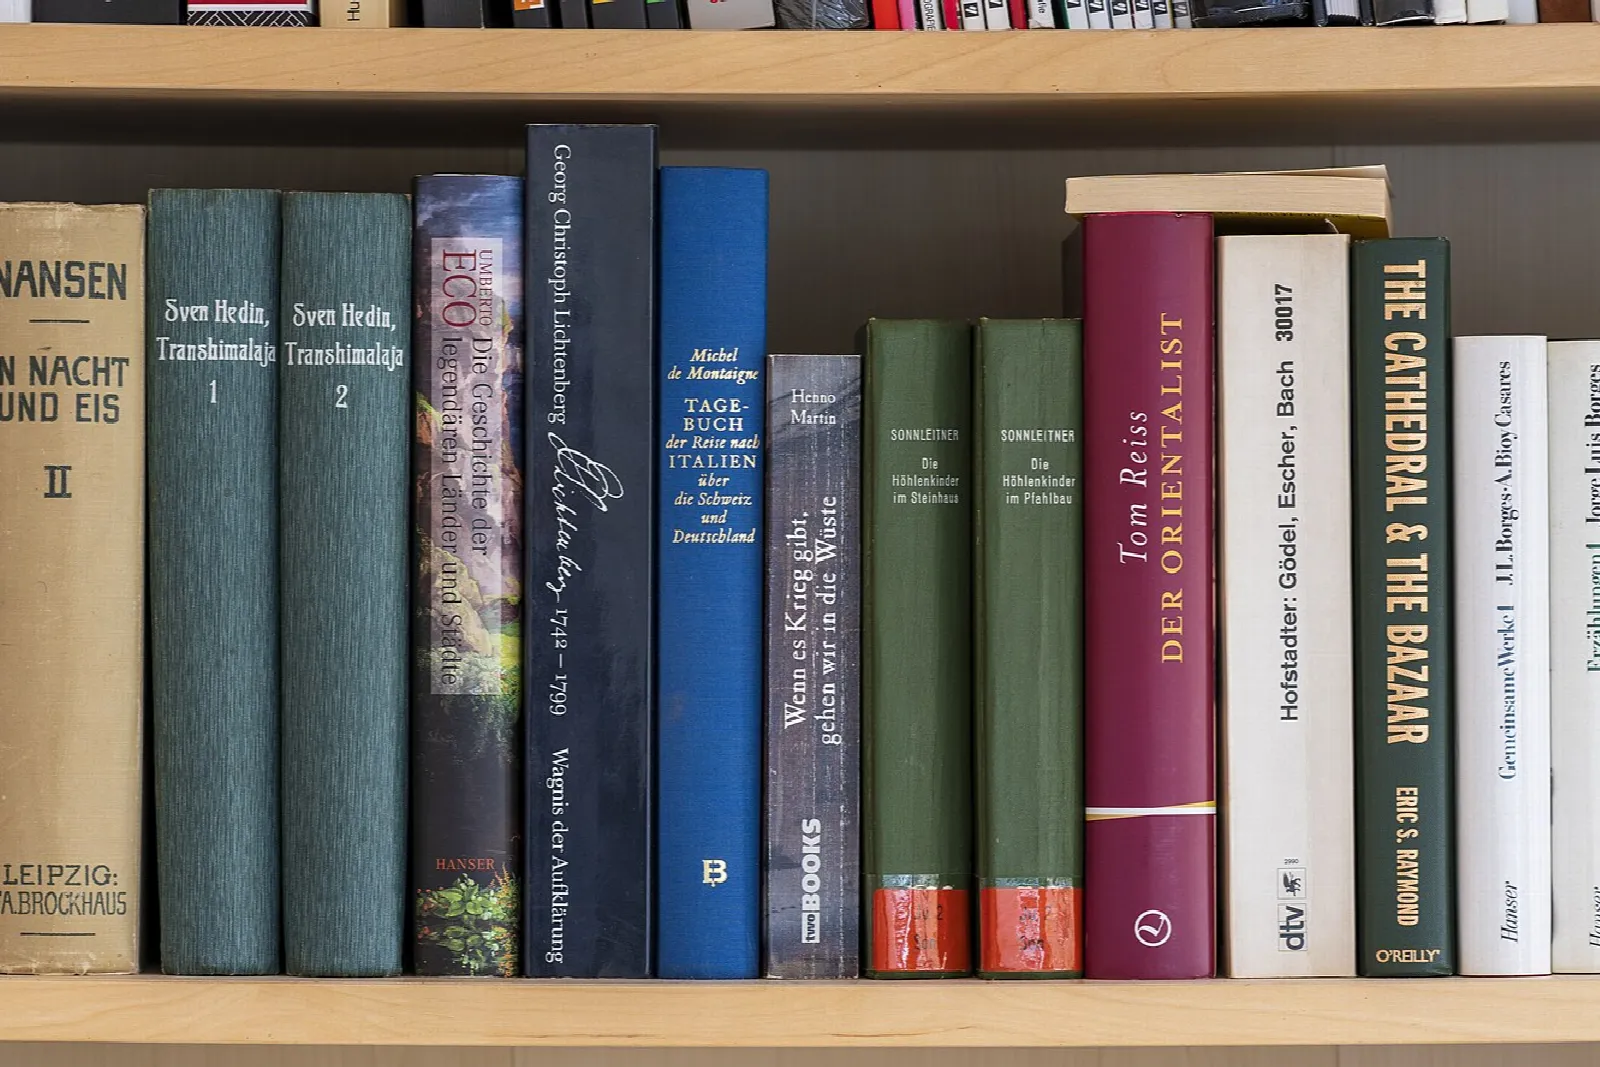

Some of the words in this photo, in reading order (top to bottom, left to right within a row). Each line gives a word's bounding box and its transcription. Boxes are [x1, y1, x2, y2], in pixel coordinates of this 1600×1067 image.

[547, 144, 572, 205] Georg
[547, 208, 572, 303] Christoph
[442, 249, 477, 327] ECO
[478, 249, 493, 326] UMBERTO
[1383, 259, 1426, 320] THE
[165, 299, 209, 322] Sven
[215, 299, 270, 328] Hedin,
[293, 303, 336, 327] Sven
[342, 303, 396, 332] Hedin,
[1274, 283, 1293, 342] 30017
[29, 356, 130, 386] NACHT
[156, 337, 277, 368] Transhimalaja
[285, 342, 404, 372] Transhimalaja
[471, 337, 493, 375] Die
[546, 308, 571, 425] Lichtenberg
[689, 347, 739, 362] Michel
[209, 380, 217, 403] 1
[667, 365, 682, 380] de
[686, 366, 759, 385] Montaigne
[1276, 360, 1295, 418] Bach
[0, 392, 58, 422] UND
[76, 394, 119, 424] EIS
[335, 385, 348, 408] 2
[437, 336, 463, 463] legendären
[684, 398, 749, 413] TAGE-
[1494, 361, 1512, 428] Casares
[683, 417, 744, 432] BUCH
[791, 409, 837, 424] Martin
[890, 429, 959, 441] SONNLEITNER
[1001, 429, 1075, 442] SONNLEITNER
[1384, 331, 1428, 512] CATHEDRAL
[471, 383, 493, 510] Geschichte
[665, 434, 688, 449] der
[692, 435, 726, 449] Reise
[730, 434, 760, 449] nach
[1119, 411, 1147, 488] Reiss
[1160, 312, 1183, 575] ORIENTALIST
[1494, 429, 1518, 467] Bioy
[668, 454, 757, 469] ITALIEN
[697, 472, 730, 487] über
[892, 474, 959, 487] Höhlenkinder
[922, 457, 938, 470] Die
[1002, 474, 1076, 487] Höhlenkinder
[1031, 457, 1049, 470] Die
[1277, 425, 1298, 509] Escher,
[44, 465, 72, 498] II
[674, 491, 694, 506] die
[697, 491, 753, 506] Schweiz
[893, 491, 907, 504] im
[911, 491, 959, 504] Steinhaus
[1006, 492, 1019, 504] im
[1024, 492, 1072, 504] Pfahlbau
[441, 475, 462, 554] Länder
[701, 509, 728, 524] und
[815, 496, 837, 564] Wüste
[1117, 503, 1147, 564] Tom
[1385, 522, 1428, 544] &
[471, 518, 492, 556] der
[672, 528, 756, 544] Deutschland
[785, 511, 814, 562] gibt,
[1278, 517, 1299, 590] Gödel,
[441, 561, 462, 604] und
[784, 569, 813, 632] Krieg
[815, 572, 836, 605] die
[1385, 552, 1428, 612] THE
[549, 608, 567, 649] 1742
[816, 612, 836, 633] in
[1161, 588, 1183, 663] DER
[1496, 615, 1515, 667] Werke
[441, 614, 462, 685] Städte
[791, 639, 806, 661] es
[816, 640, 836, 675] wir
[1280, 597, 1298, 721] Hofstadter:
[549, 674, 567, 716] 1799
[783, 668, 806, 729] Wenn
[1385, 624, 1429, 744] BAZAAR
[813, 682, 842, 745] gehen
[1497, 667, 1516, 780] Gemeinsame
[545, 748, 570, 815] Wagnis
[1396, 787, 1419, 823] ERIC
[551, 820, 569, 853] der
[1396, 828, 1419, 843] S.
[3, 864, 118, 886] LEIPZIG:
[435, 858, 495, 870] HANSER
[1396, 849, 1419, 926] RAYMOND
[544, 855, 570, 964] Aufklärung
[1280, 906, 1304, 951] dtv
[1500, 880, 1518, 943] Hanser
